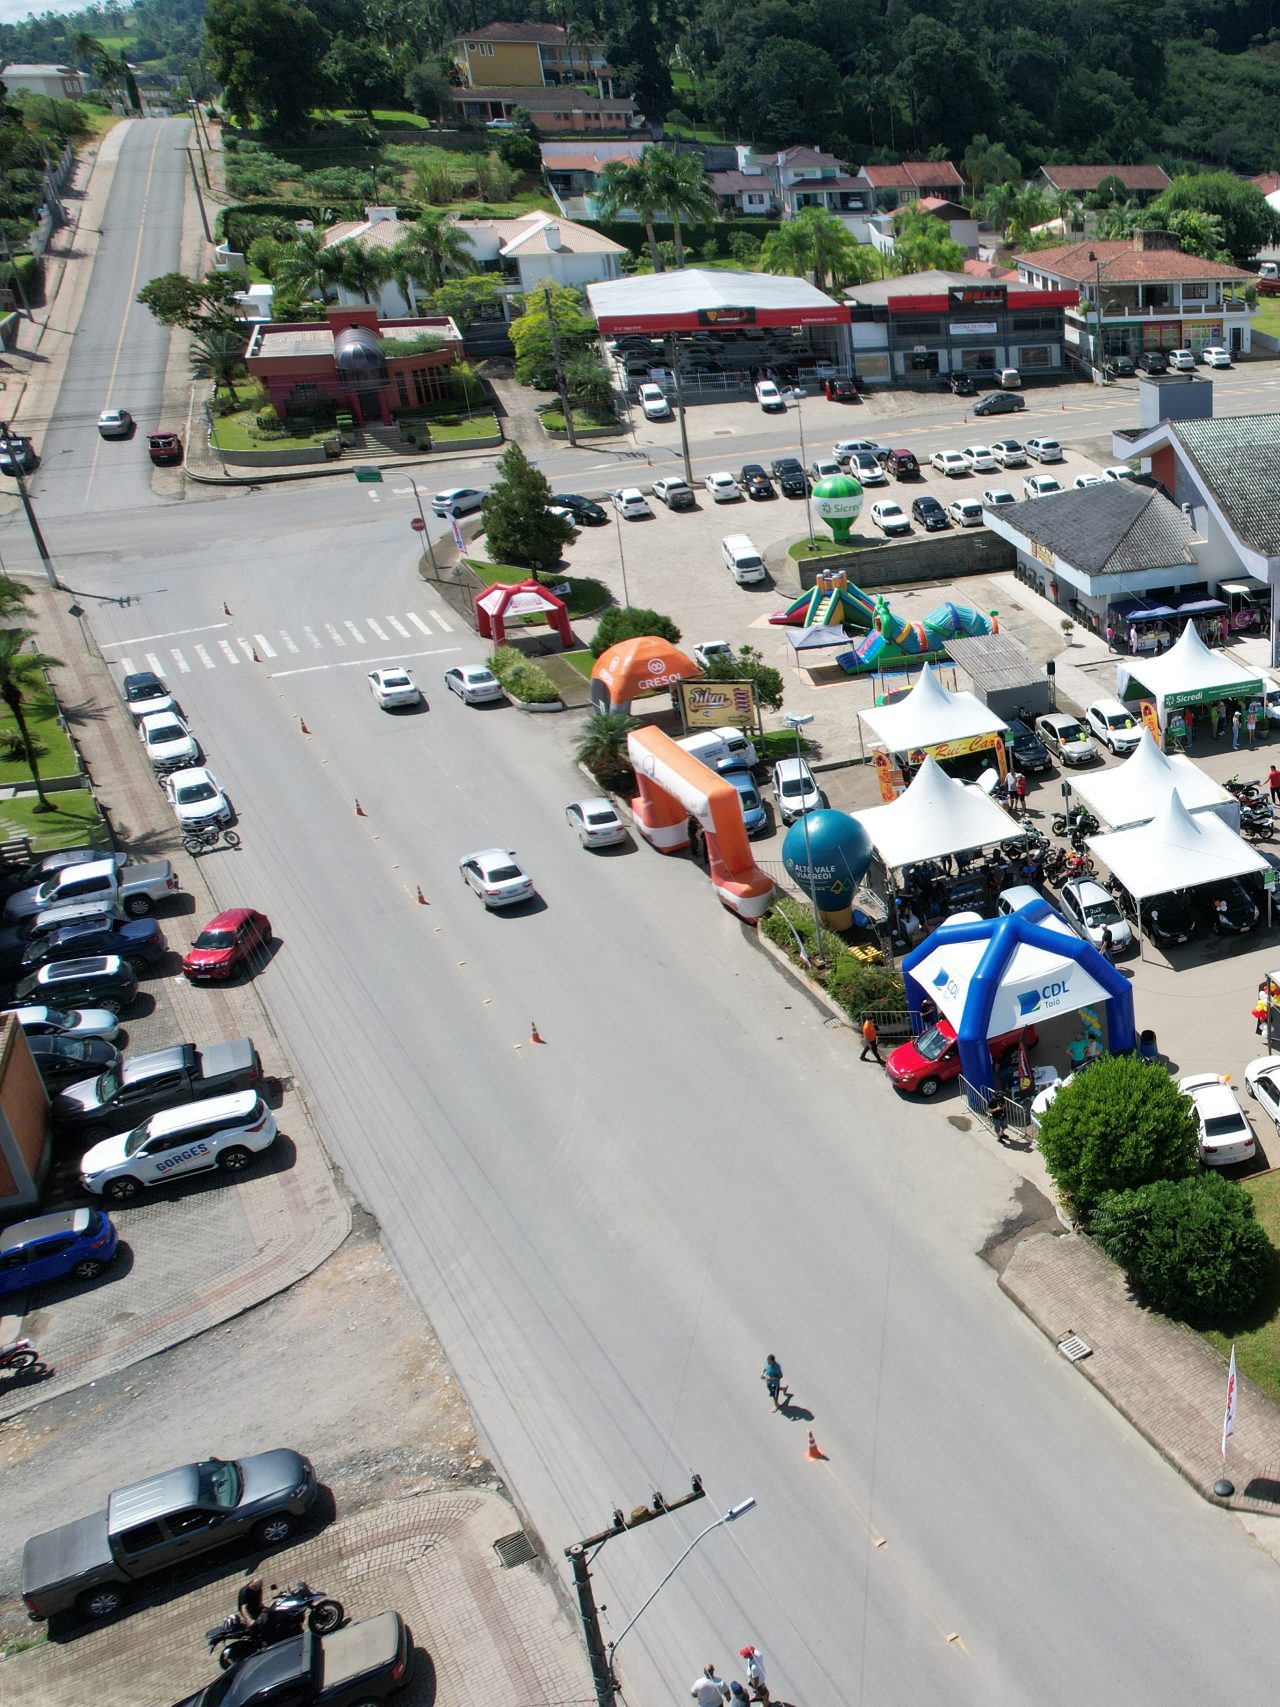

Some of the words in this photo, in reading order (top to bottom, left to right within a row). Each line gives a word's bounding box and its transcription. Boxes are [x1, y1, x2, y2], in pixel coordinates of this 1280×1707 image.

[1176, 691, 1203, 704] Sicredi
[815, 865, 837, 873] VALE
[946, 979, 961, 1000] CDL
[1042, 980, 1070, 999] CDL
[1044, 999, 1061, 1009] Taió
[155, 1143, 208, 1172] GORGES
